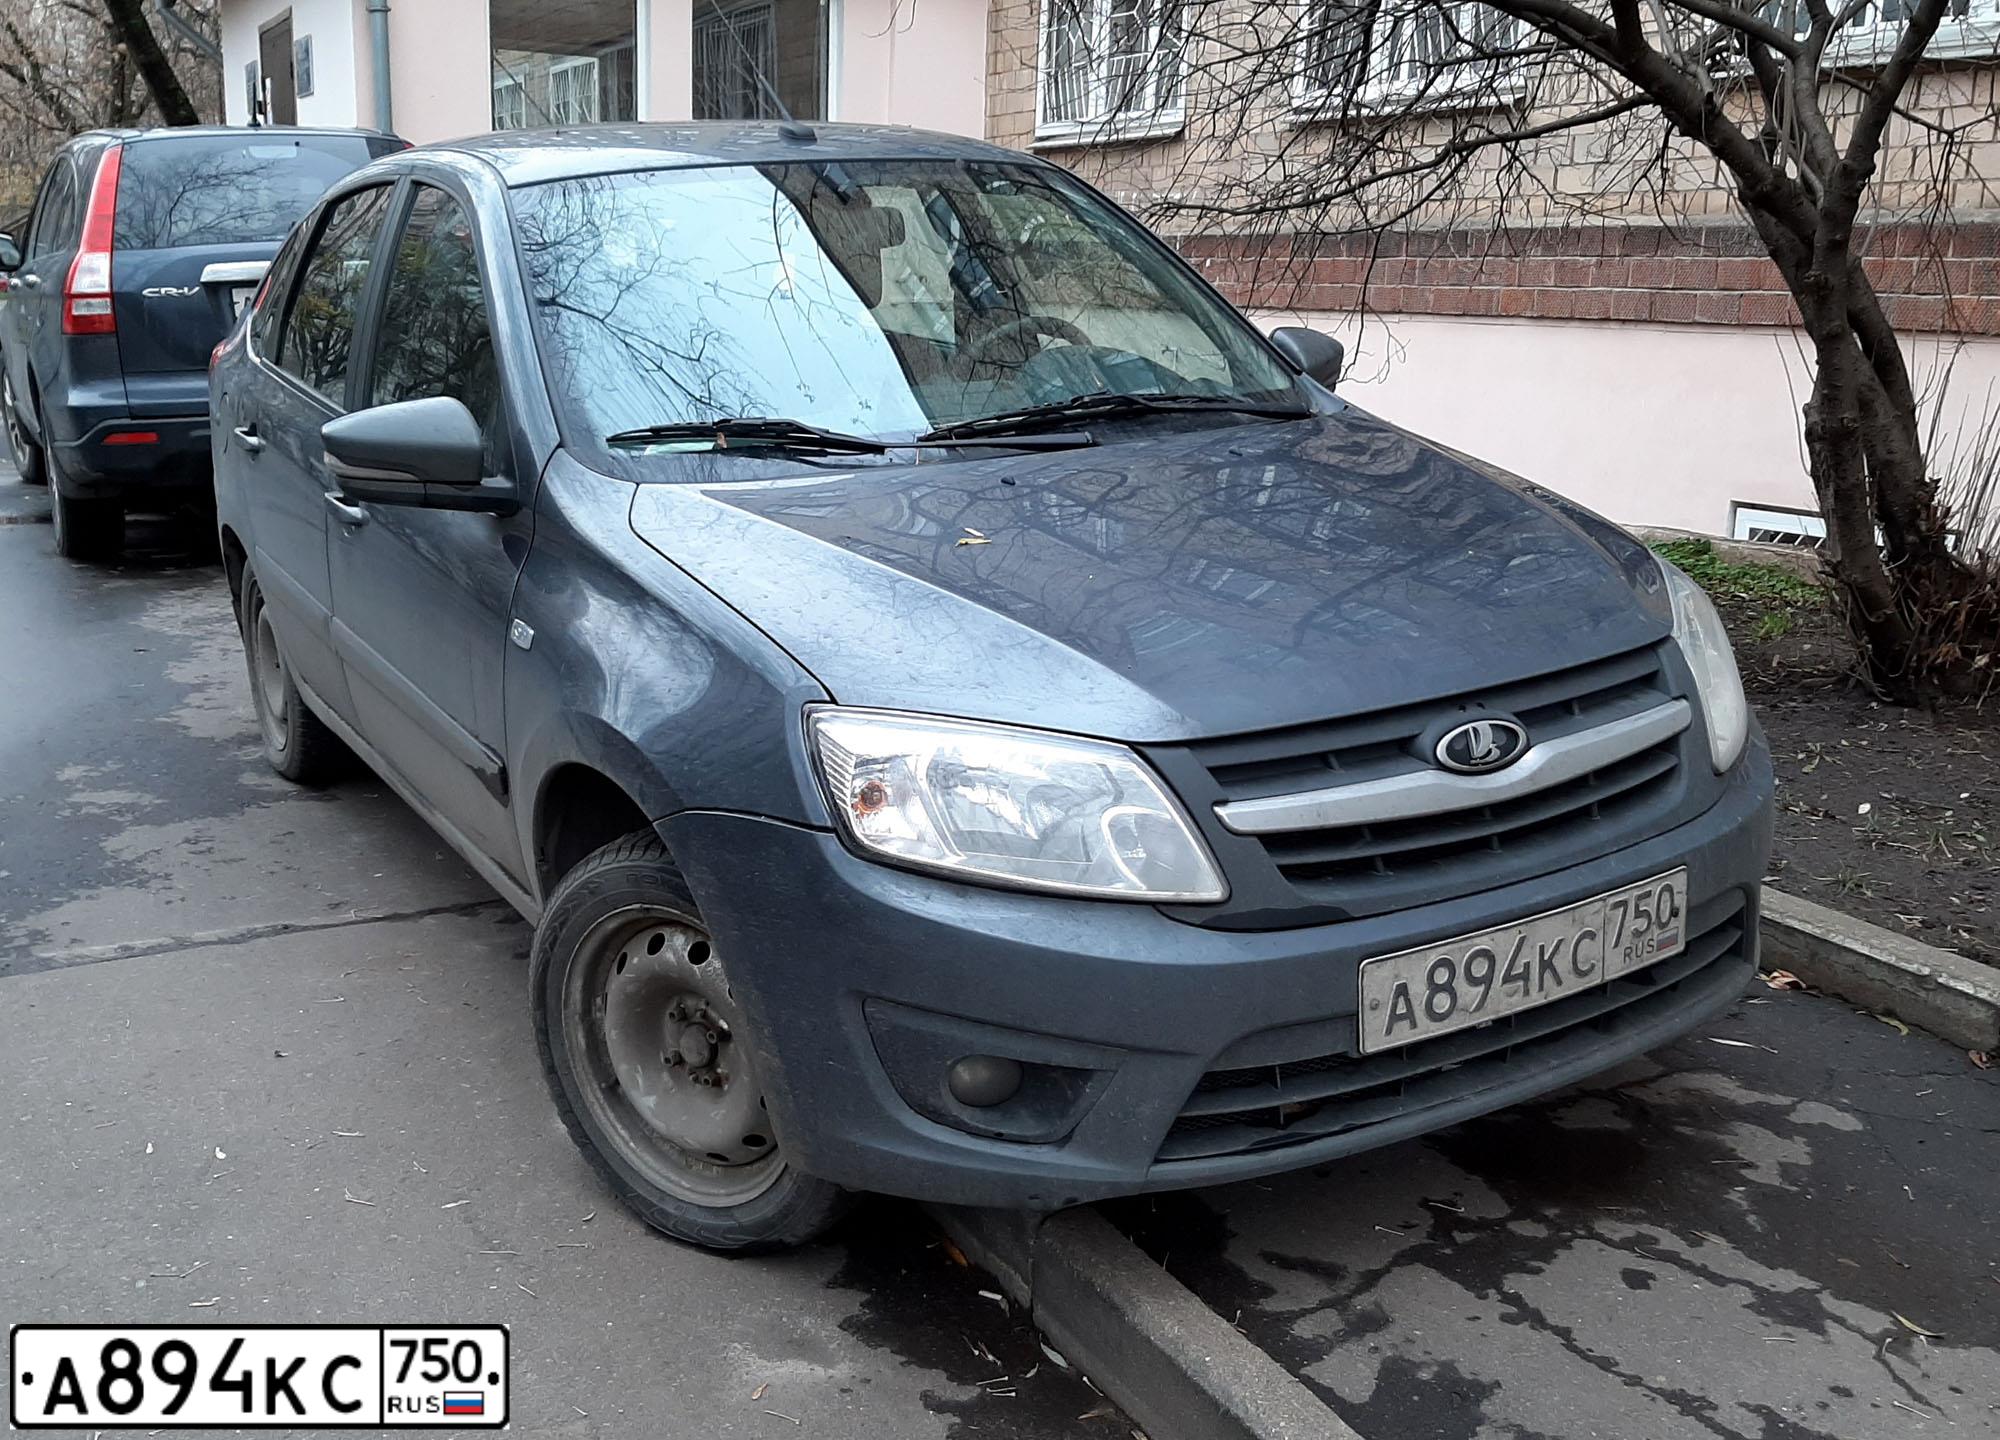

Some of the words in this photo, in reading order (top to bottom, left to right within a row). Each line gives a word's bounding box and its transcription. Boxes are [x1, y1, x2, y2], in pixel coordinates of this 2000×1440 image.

[142, 286, 200, 297] CR-V
[1383, 927, 1598, 1037] А894КС
[1608, 881, 1675, 950] 750
[1622, 937, 1656, 964] RUS
